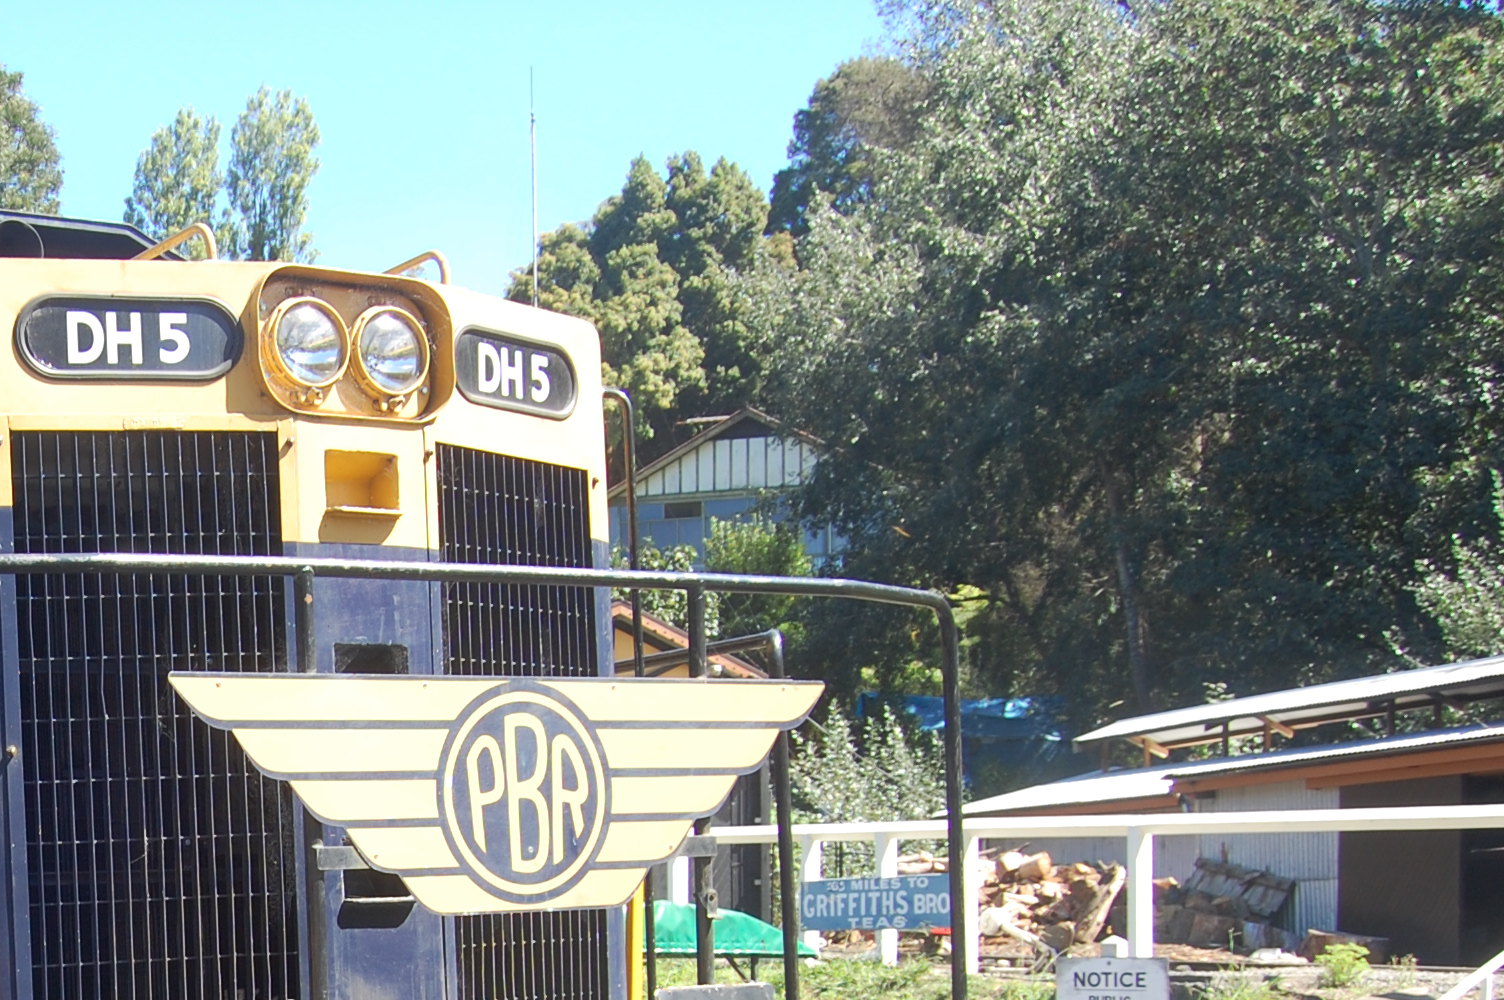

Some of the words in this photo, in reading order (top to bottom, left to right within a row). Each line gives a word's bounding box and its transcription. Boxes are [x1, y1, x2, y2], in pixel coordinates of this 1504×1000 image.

[66, 310, 143, 365] DH
[158, 311, 191, 365] 5
[478, 341, 524, 400] DH
[530, 353, 551, 403] 5
[466, 712, 589, 874] PBR
[850, 877, 901, 891] MILES
[907, 876, 929, 889] TO
[803, 890, 908, 918] GRIFFITHS
[847, 916, 907, 929] TEAS
[1073, 972, 1147, 988] NOTICE
